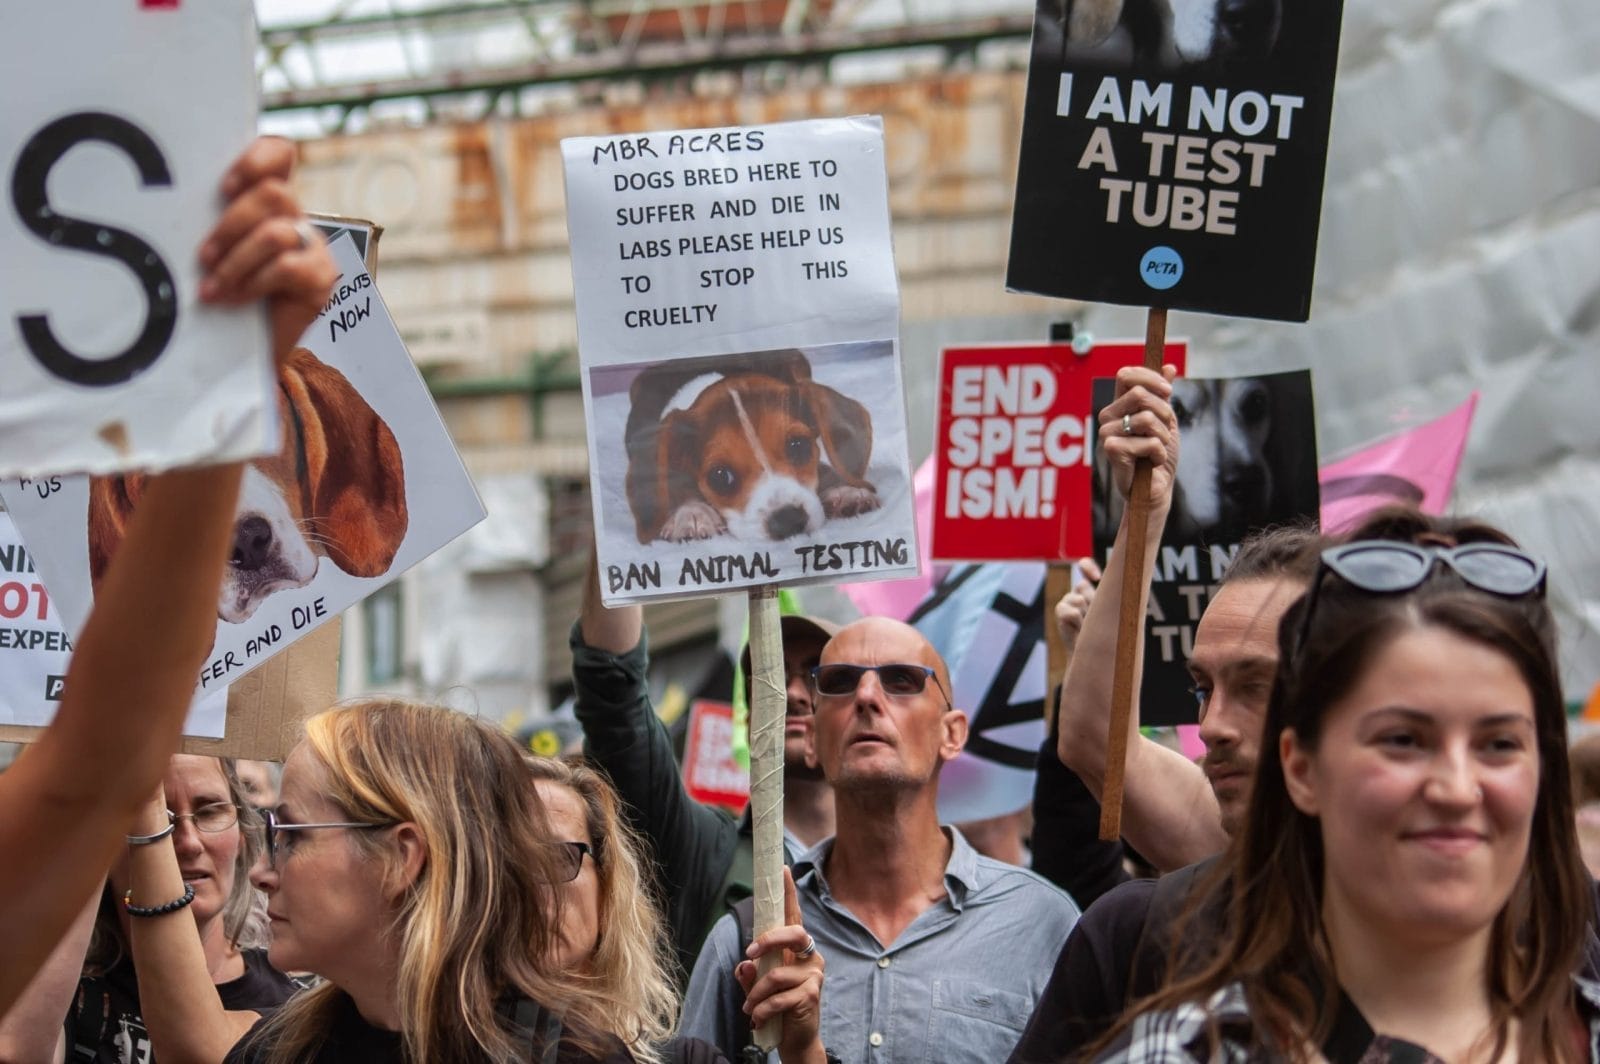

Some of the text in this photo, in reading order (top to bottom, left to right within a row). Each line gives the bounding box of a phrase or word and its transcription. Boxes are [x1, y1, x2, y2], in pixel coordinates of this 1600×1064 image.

[1056, 72, 1304, 140] I AM NOT
[593, 131, 764, 165] MBR ACRES
[1077, 126, 1277, 187] A TEST
[614, 159, 838, 192] DOGS BRED HERE TO
[616, 194, 840, 226] SUFFER AND DIE IN
[1099, 178, 1240, 235] TUBE
[11, 111, 178, 388] S
[619, 227, 844, 260] LABS PLEASE HELP US
[621, 261, 848, 294] TO STOP THIS
[329, 296, 371, 342] NOW
[625, 304, 718, 328] CRUELTY
[952, 365, 1057, 416] END
[36, 475, 62, 499] US
[945, 467, 1057, 519] ISM!
[607, 538, 908, 594] BAN ANIMAL TESTING
[246, 625, 281, 658] AND
[292, 597, 327, 630] DIE
